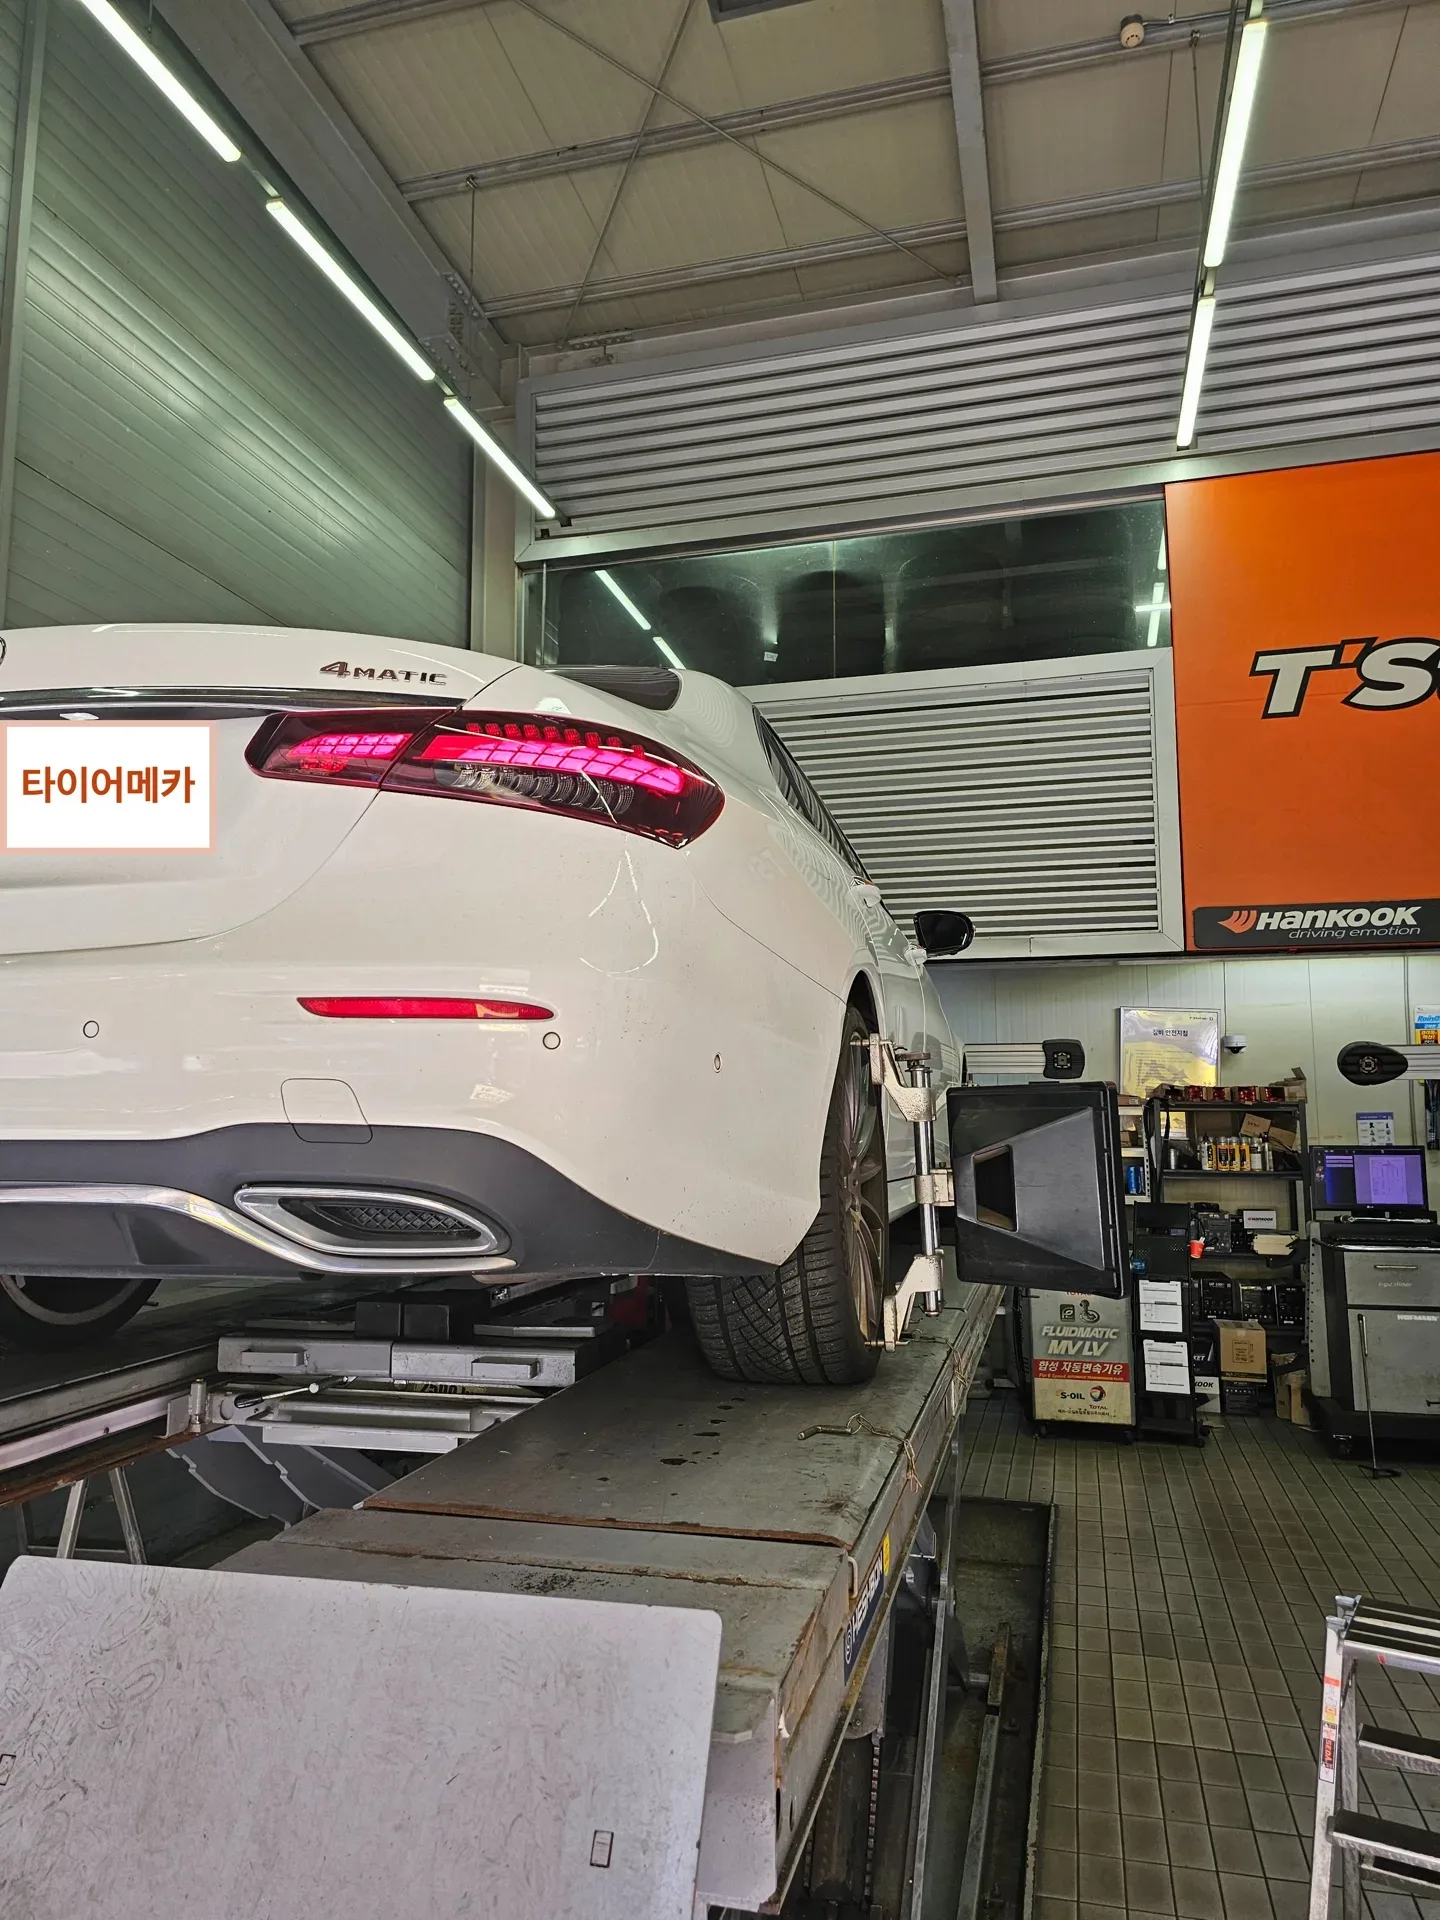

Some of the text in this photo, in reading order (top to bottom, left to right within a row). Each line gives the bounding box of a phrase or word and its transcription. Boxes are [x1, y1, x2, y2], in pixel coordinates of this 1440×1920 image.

[319, 661, 447, 685] 4MATIC
[1249, 636, 1440, 719] T'S
[1288, 925, 1421, 939] driving emotion
[1041, 1325, 1120, 1339] FLUIDMATIC
[1038, 1360, 1123, 1375] 합성 자동변속기유
[1060, 1391, 1085, 1400] S-OIL
